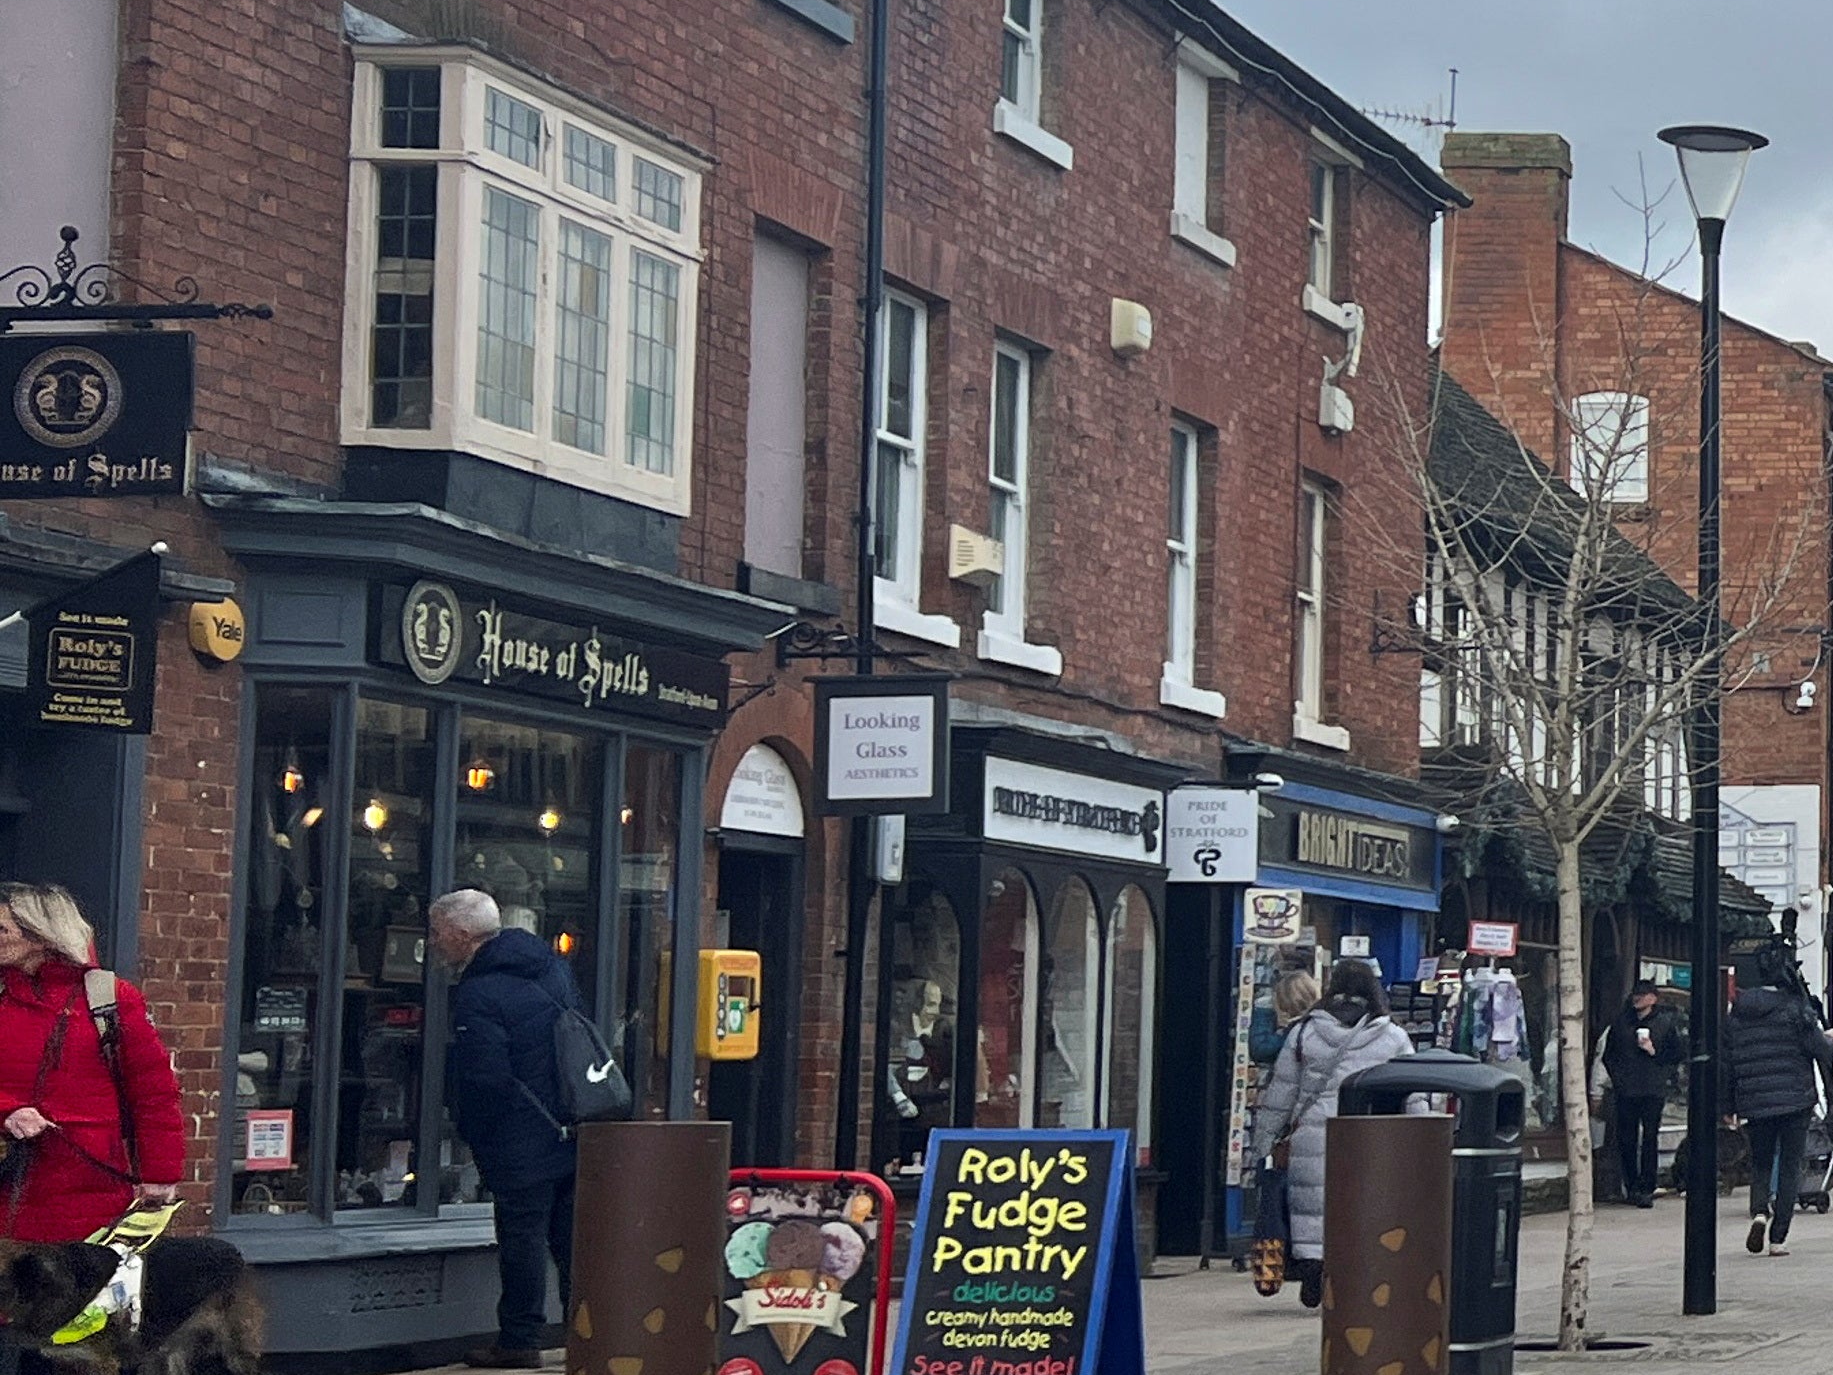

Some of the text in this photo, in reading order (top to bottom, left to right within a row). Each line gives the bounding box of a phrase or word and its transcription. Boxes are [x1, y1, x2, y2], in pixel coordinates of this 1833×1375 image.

[1, 453, 174, 494] use of Spells
[213, 615, 243, 643] Yale
[58, 636, 123, 657] Roly's
[475, 598, 650, 709] House of Spells
[58, 656, 121, 673] FUDGE
[843, 712, 921, 732] Looking
[856, 742, 908, 759] Glass
[844, 767, 919, 780] AESTHETICS
[1187, 801, 1228, 811] PRIDE
[1170, 827, 1249, 838] STRATFORD
[1299, 811, 1359, 869] BRIGHT
[958, 1147, 1088, 1191] Roly's
[943, 1189, 1087, 1237] Fudge
[932, 1235, 1087, 1281] Pantry
[953, 1280, 1056, 1304] delicious
[925, 1307, 1075, 1329] creamy handmade
[942, 1328, 1051, 1352] devon fudge
